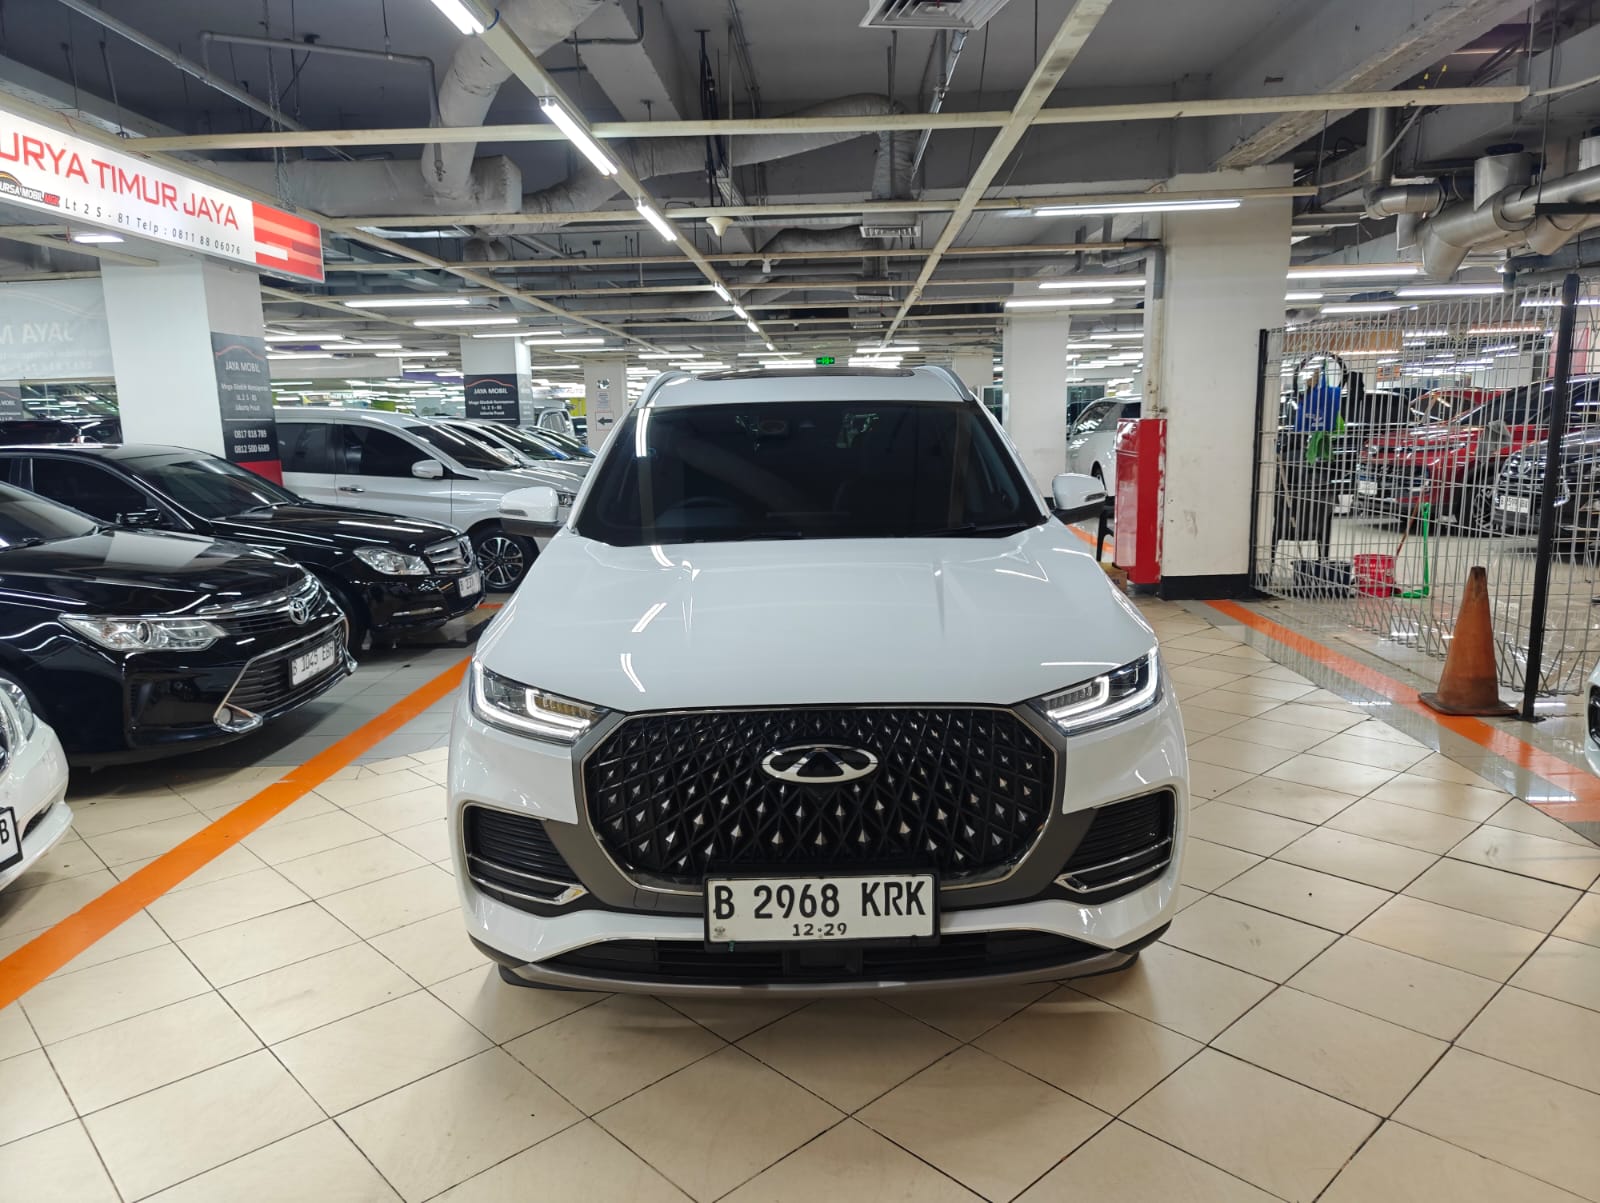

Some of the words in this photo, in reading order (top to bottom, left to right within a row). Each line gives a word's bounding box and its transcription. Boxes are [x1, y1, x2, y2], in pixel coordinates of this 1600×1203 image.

[21, 186, 44, 202] MOBIL
[92, 159, 178, 211] TIMUR
[183, 193, 239, 230] JAYA
[65, 197, 77, 211] Lt
[84, 204, 90, 214] 2
[96, 208, 102, 218] S
[117, 212, 130, 225] 81
[136, 217, 159, 234] Telp
[172, 229, 195, 242] 0811
[200, 235, 210, 246] 88
[215, 240, 240, 255] 06076
[225, 360, 240, 370] JAYA
[240, 361, 261, 373] MOBIL
[0, 818, 10, 846] B
[713, 885, 736, 920] B
[753, 882, 840, 919] 2968
[861, 881, 927, 917] KRK
